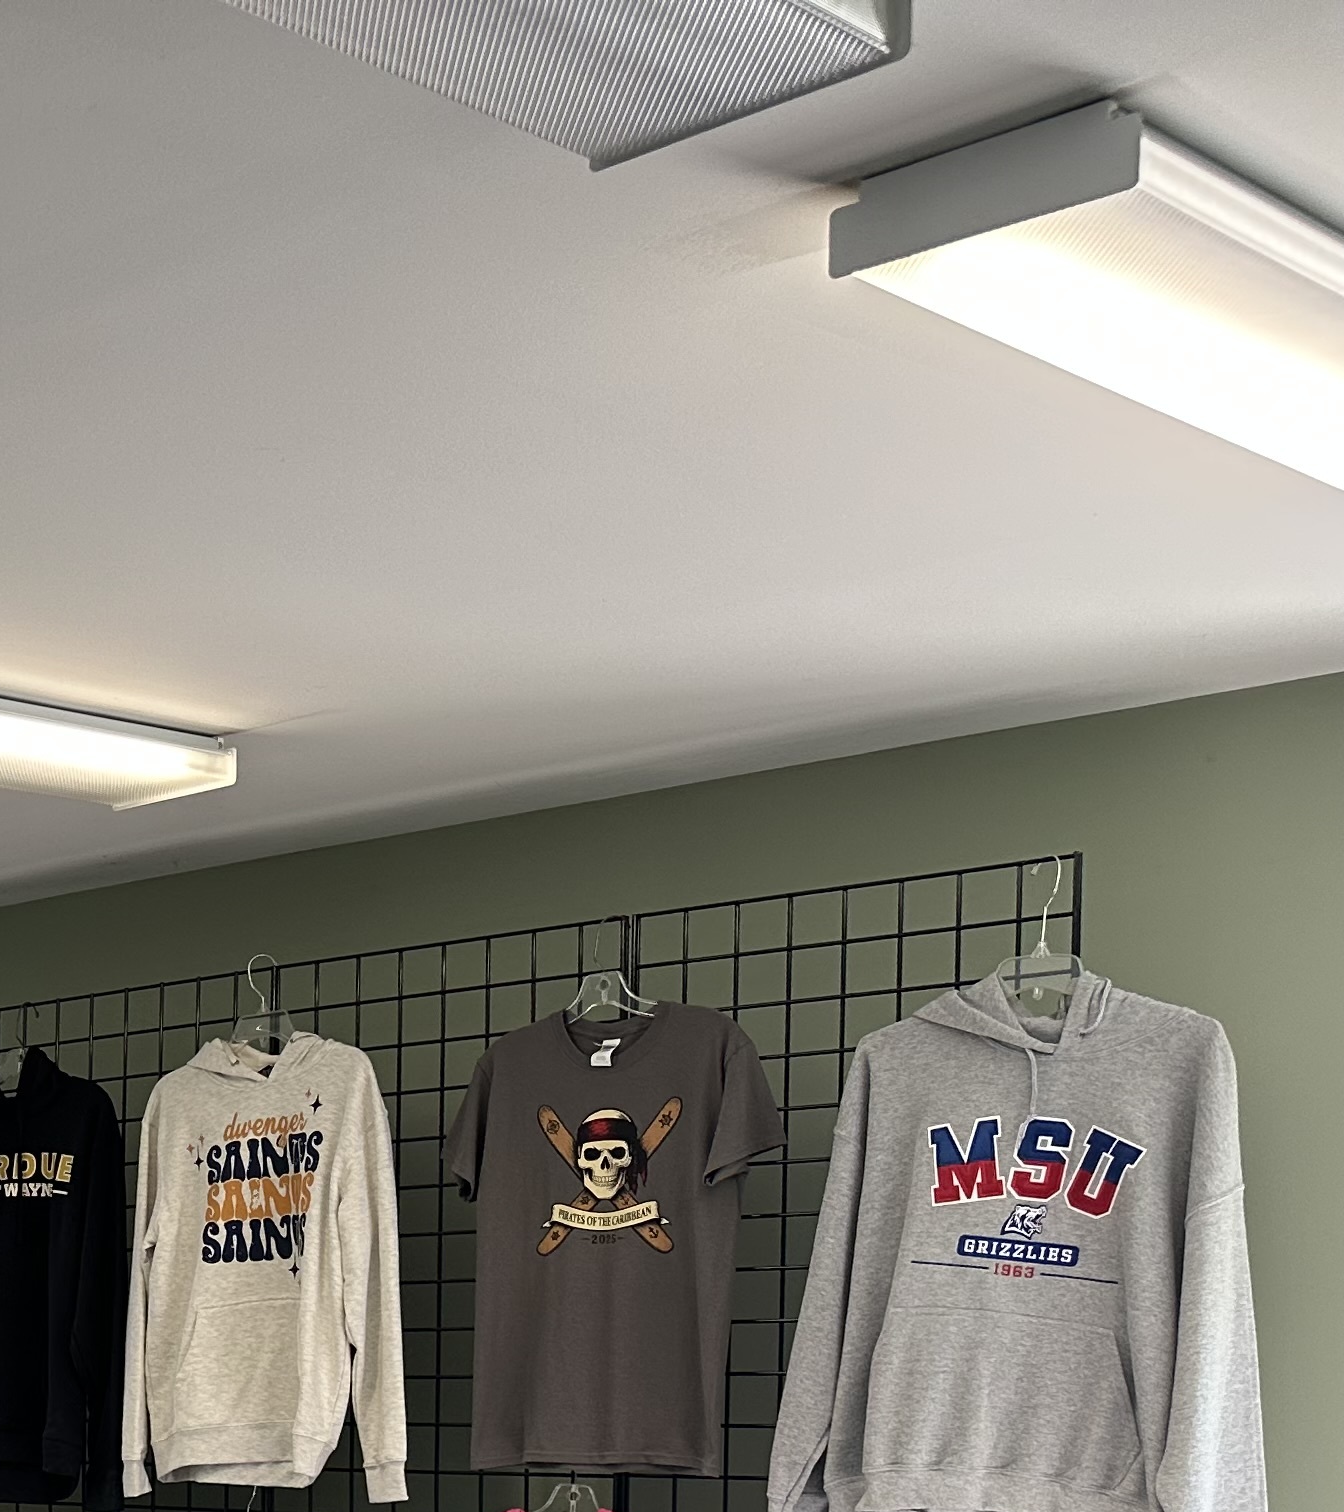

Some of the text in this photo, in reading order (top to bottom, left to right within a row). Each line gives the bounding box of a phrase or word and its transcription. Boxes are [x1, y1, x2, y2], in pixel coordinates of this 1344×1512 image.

[223, 1112, 308, 1148] dwenger
[207, 1131, 323, 1185] SAINTS
[928, 1115, 1147, 1219] MSU
[205, 1172, 314, 1223] SAINTS
[558, 1205, 652, 1226] PIRATES OF THE CARIBBEAN
[592, 1234, 617, 1244] 2025
[963, 1238, 1073, 1263] GRIZZLIES
[993, 1263, 1035, 1278] 1963
